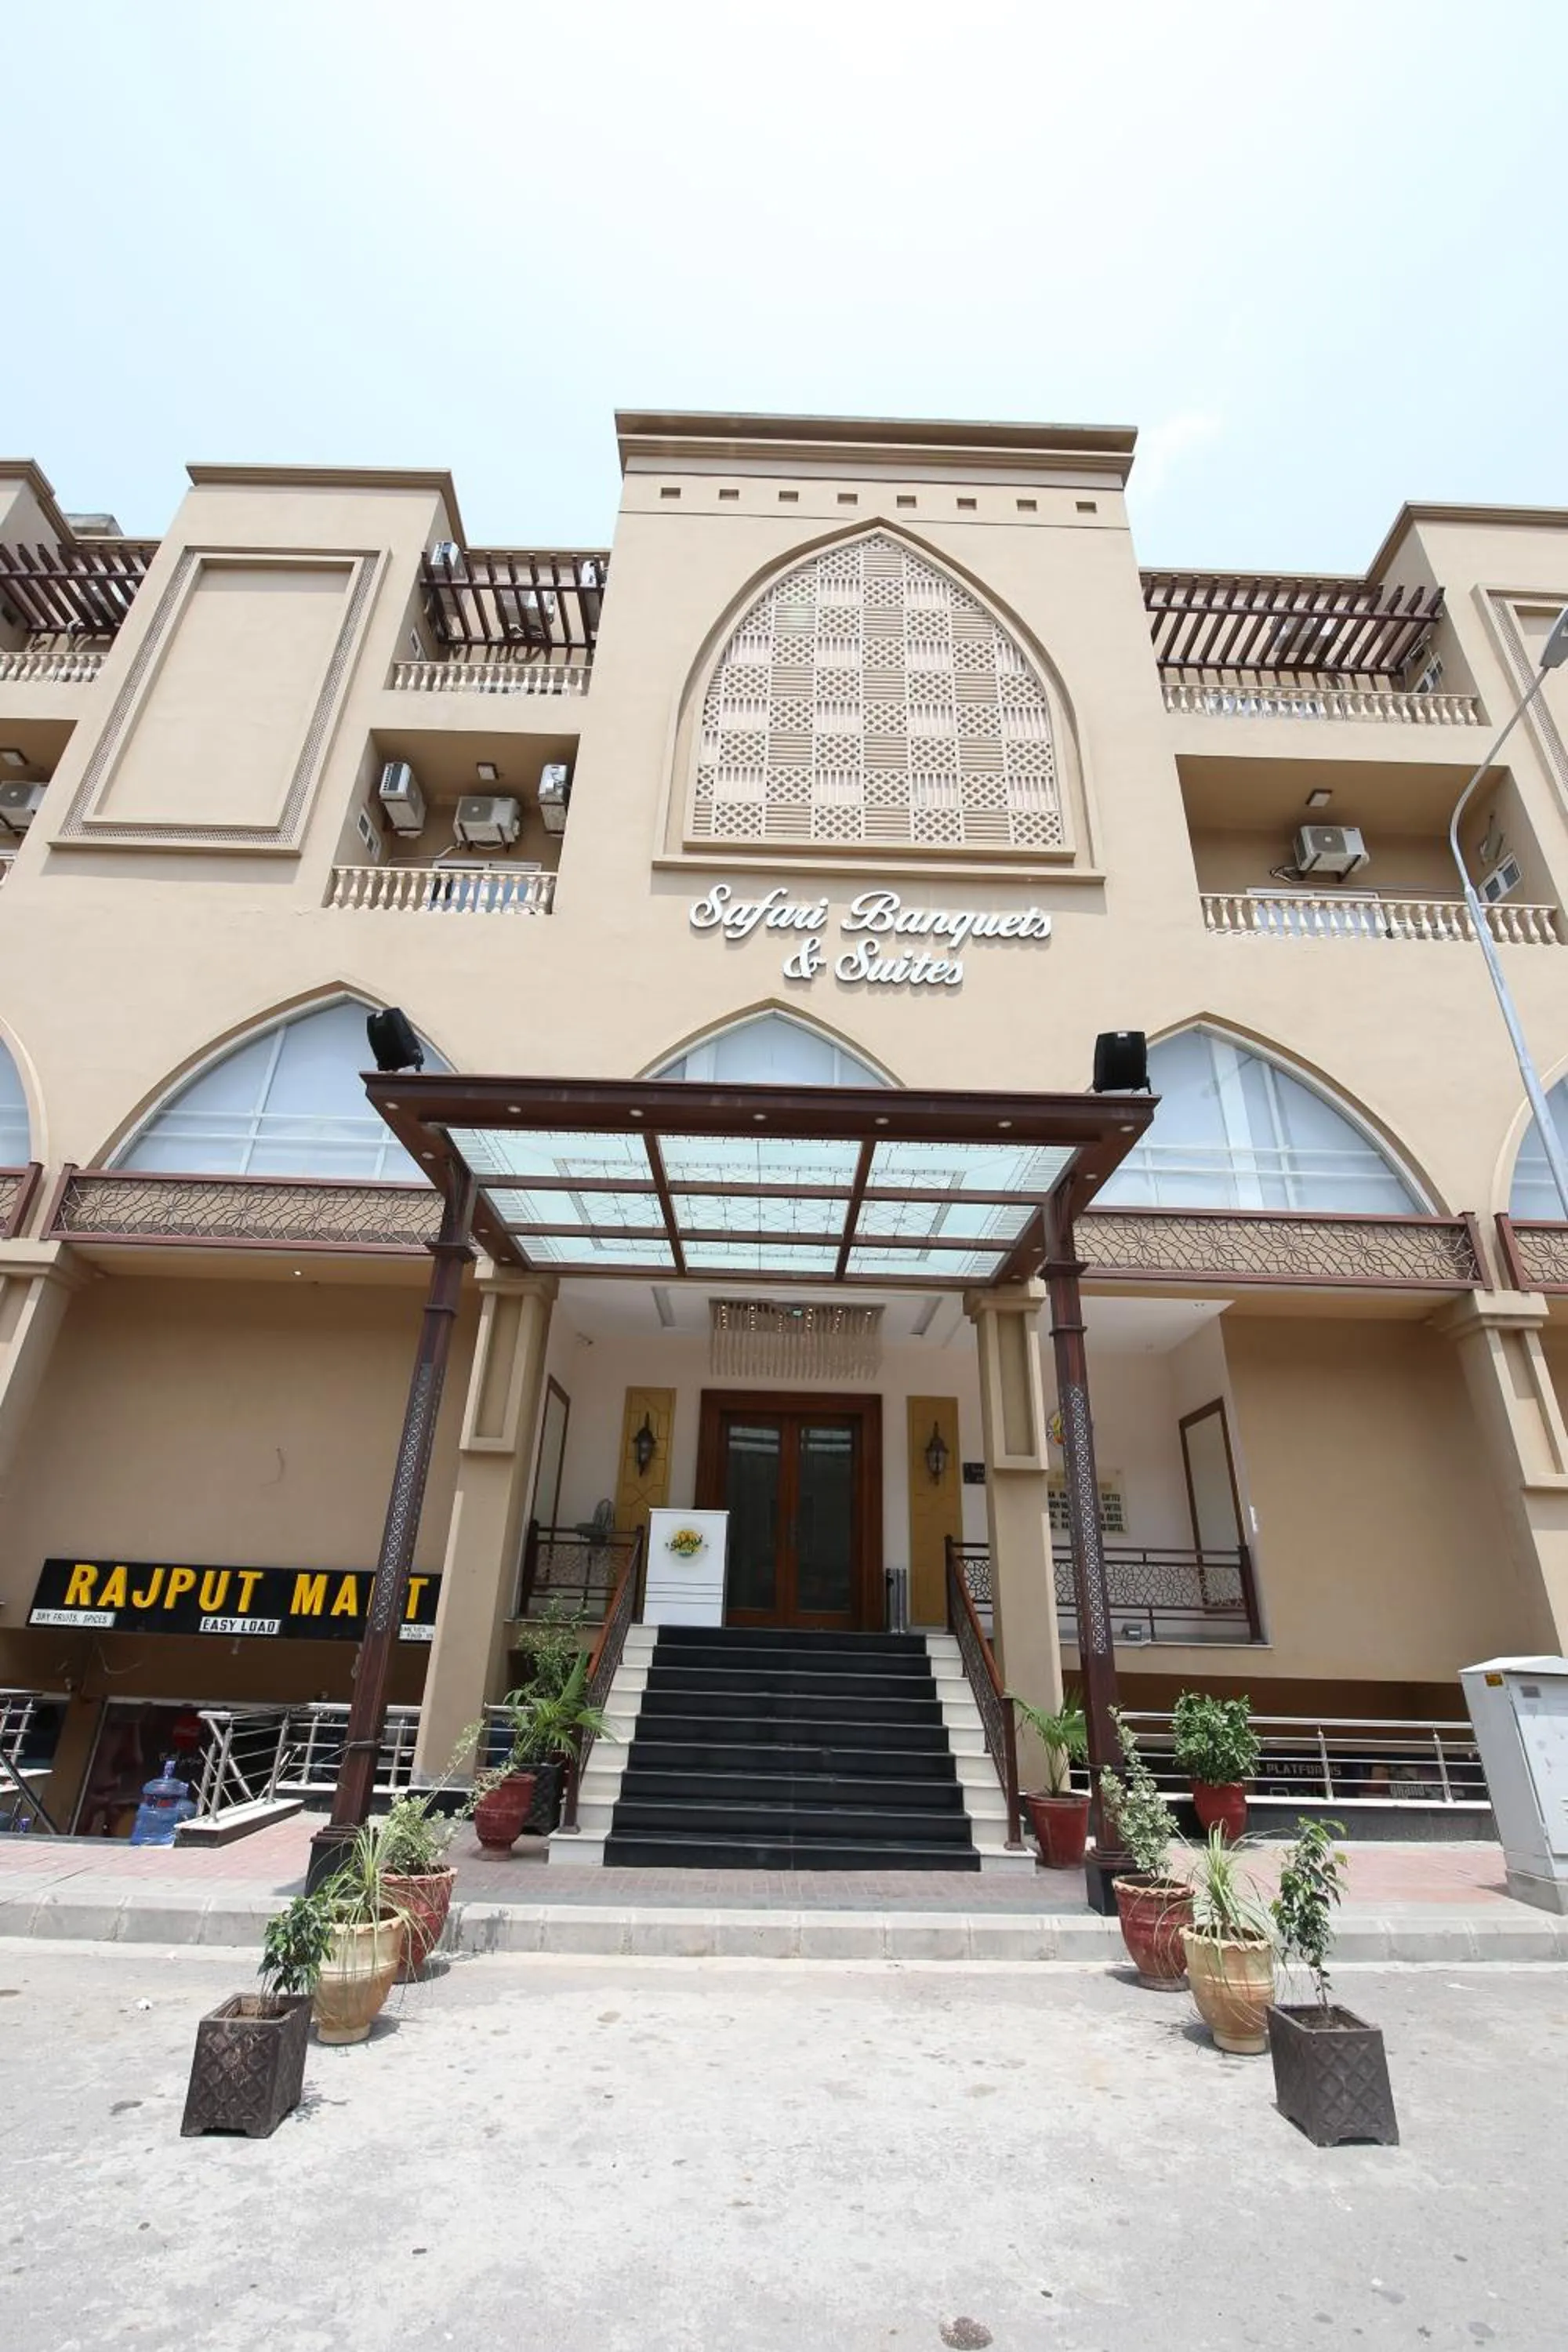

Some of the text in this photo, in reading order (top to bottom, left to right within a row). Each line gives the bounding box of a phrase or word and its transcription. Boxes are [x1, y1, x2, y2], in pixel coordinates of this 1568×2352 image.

[690, 884, 1053, 949] Safari Banquets
[782, 937, 964, 985] & Suites
[64, 1564, 429, 1619] RAJPUT MAT
[203, 1617, 275, 1632] EASY LOAD
[1265, 1762, 1342, 1776] PLATFORS
